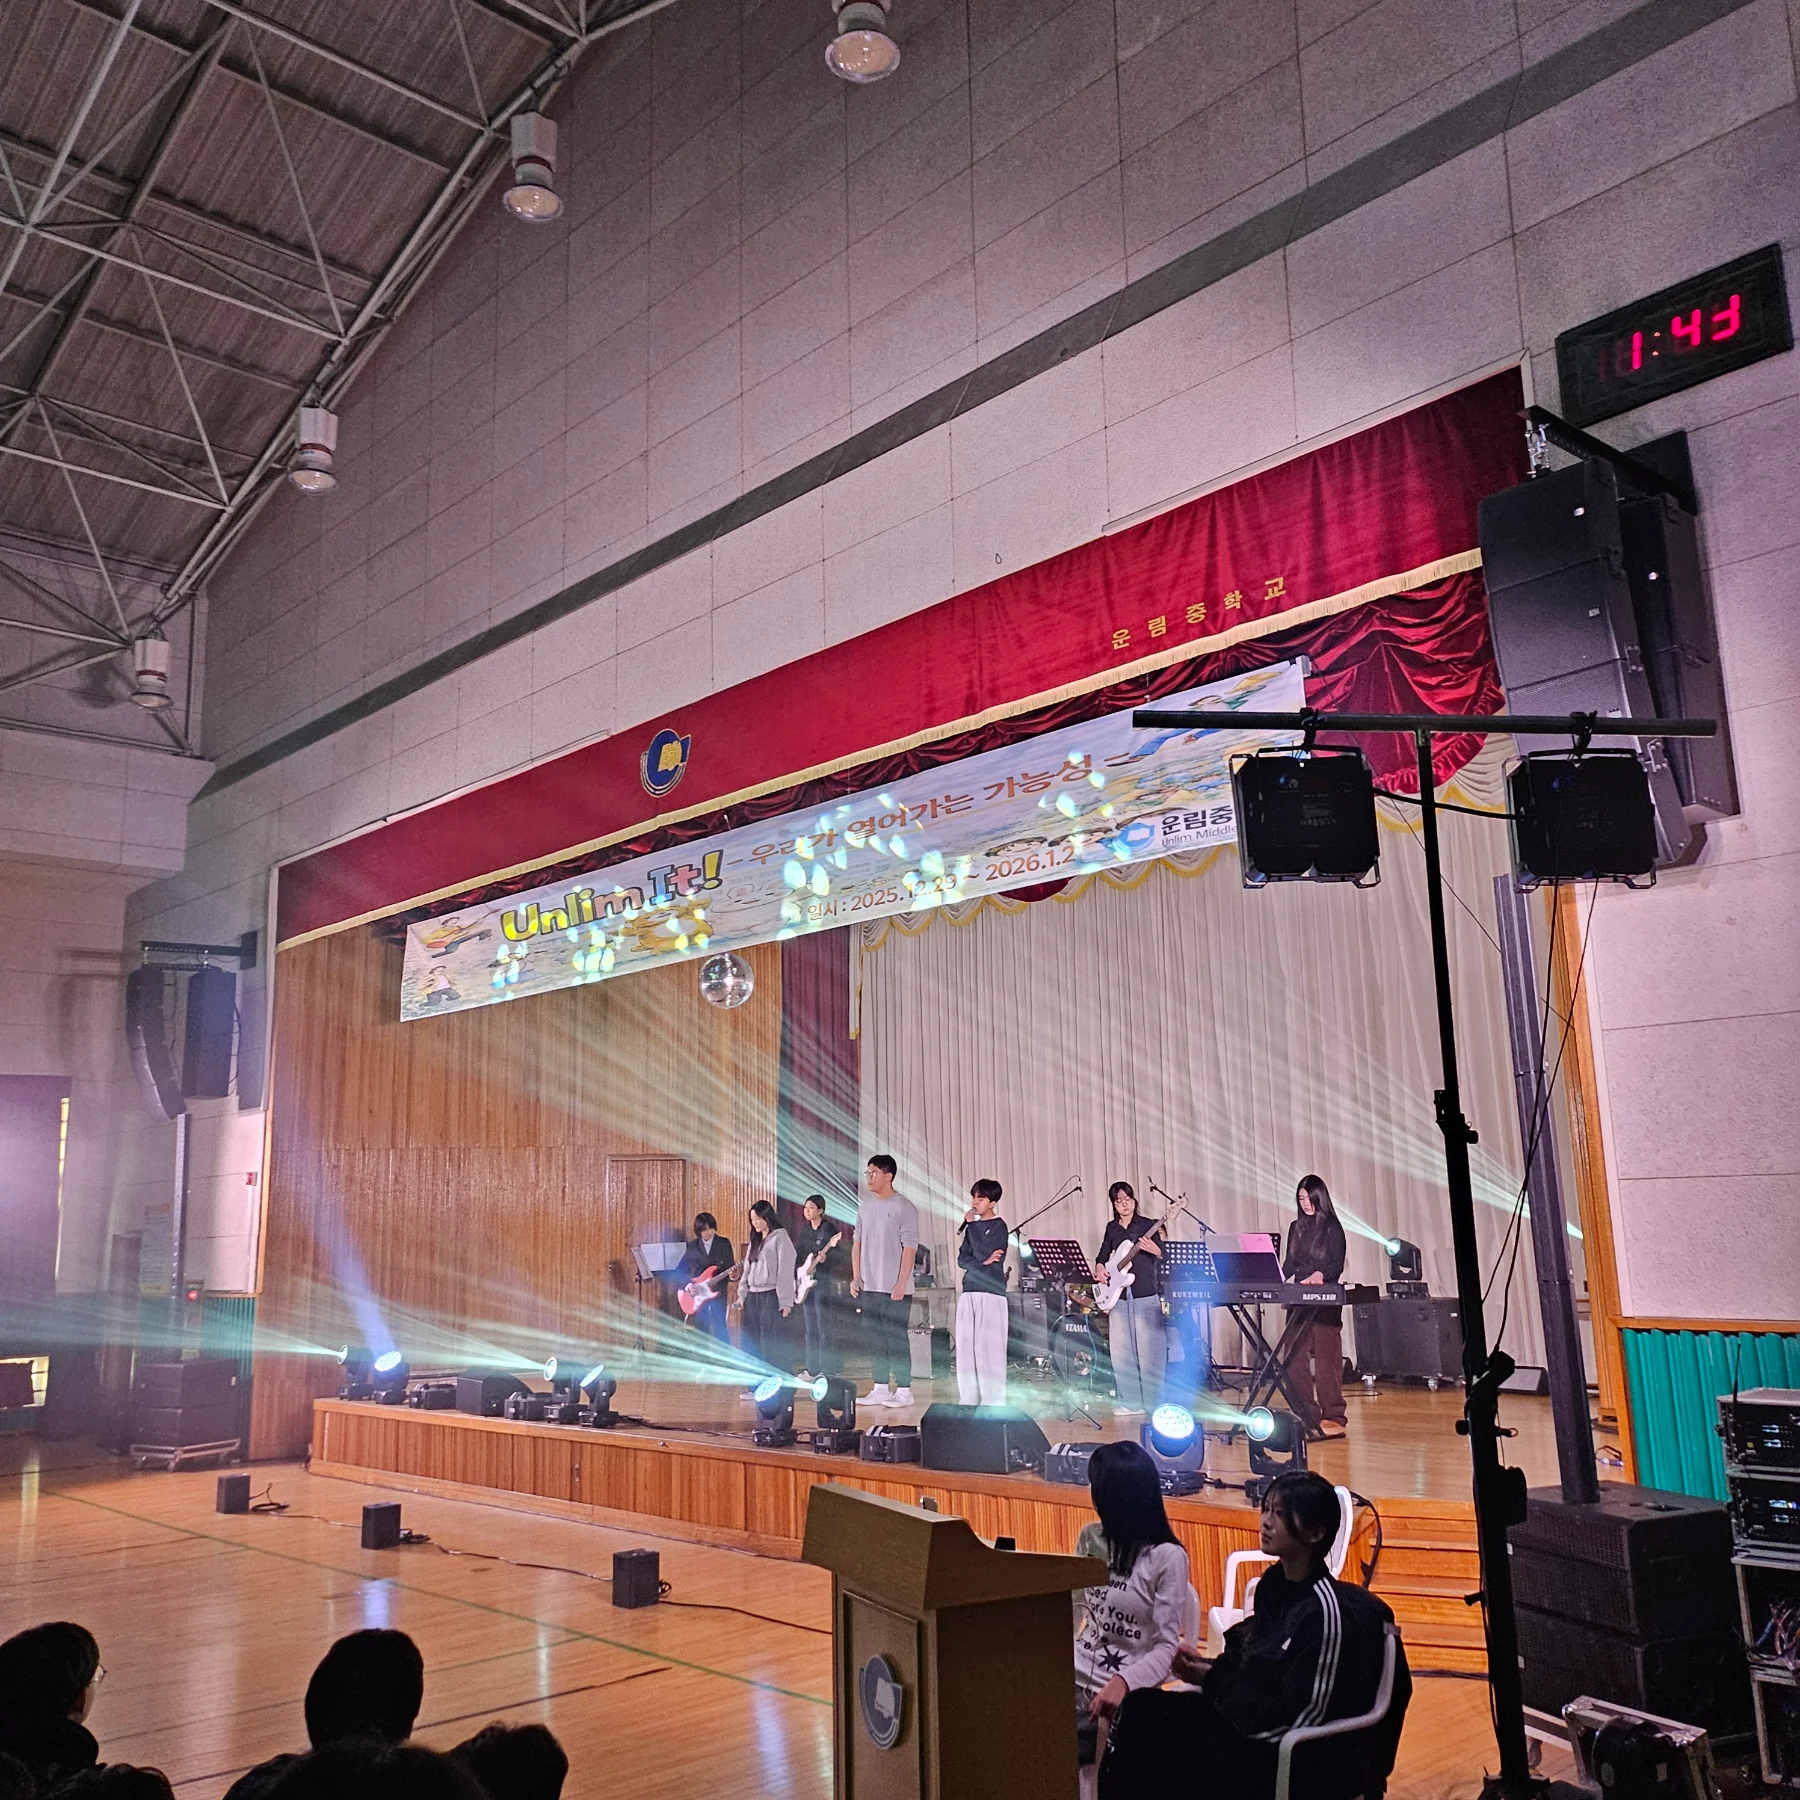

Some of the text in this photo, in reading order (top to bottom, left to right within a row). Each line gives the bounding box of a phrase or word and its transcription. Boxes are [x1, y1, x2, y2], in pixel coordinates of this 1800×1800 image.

[749, 828, 838, 866] 우리가
[847, 792, 975, 841] 열어가는
[983, 753, 1093, 801] 가능성
[1161, 833, 1192, 848] Unlim
[1172, 1290, 1212, 1299] KURZWEIL
[1108, 1579, 1128, 1592] een
[1108, 1605, 1139, 1625] You.
